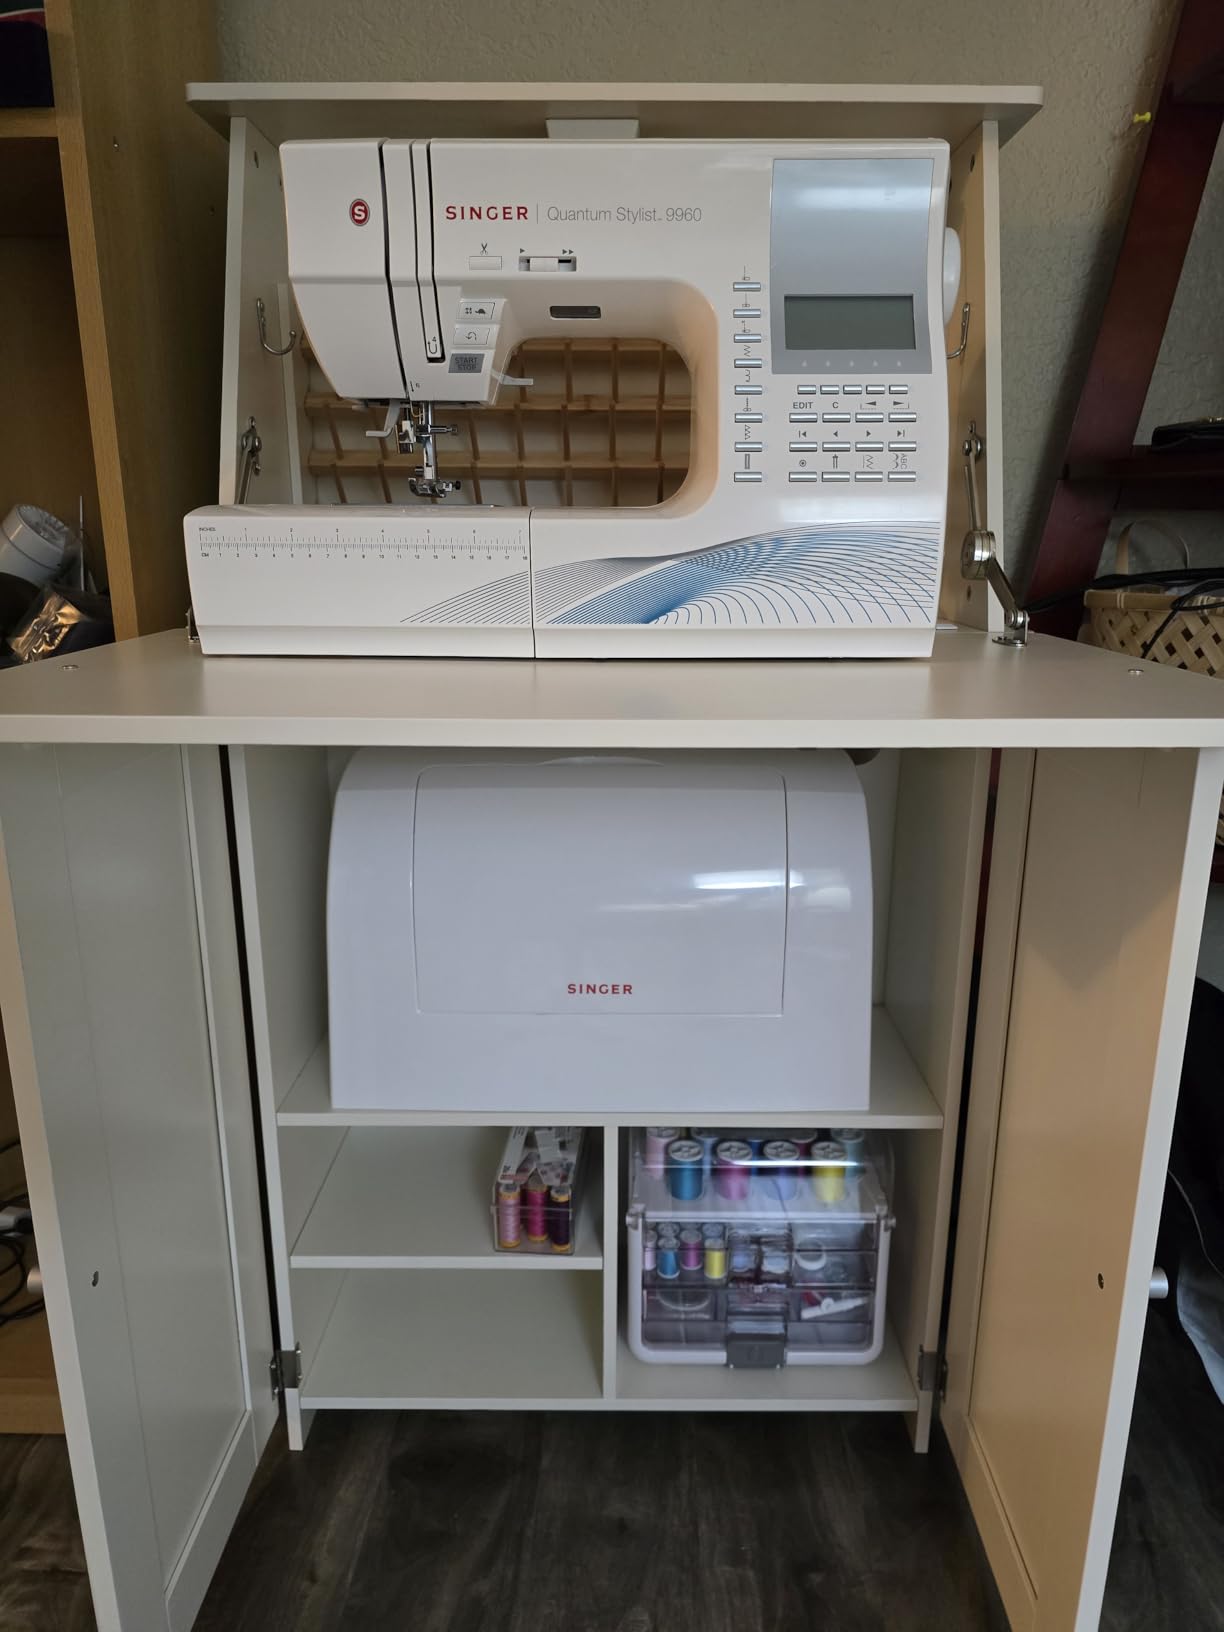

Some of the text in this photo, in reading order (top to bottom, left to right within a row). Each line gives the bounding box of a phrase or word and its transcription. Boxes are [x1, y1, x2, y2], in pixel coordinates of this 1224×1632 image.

[446, 206, 528, 221] SINGER
[547, 206, 612, 221] Quantum
[665, 207, 702, 222] 9960
[793, 402, 839, 410] EDIT C
[567, 983, 633, 995] SINGER
